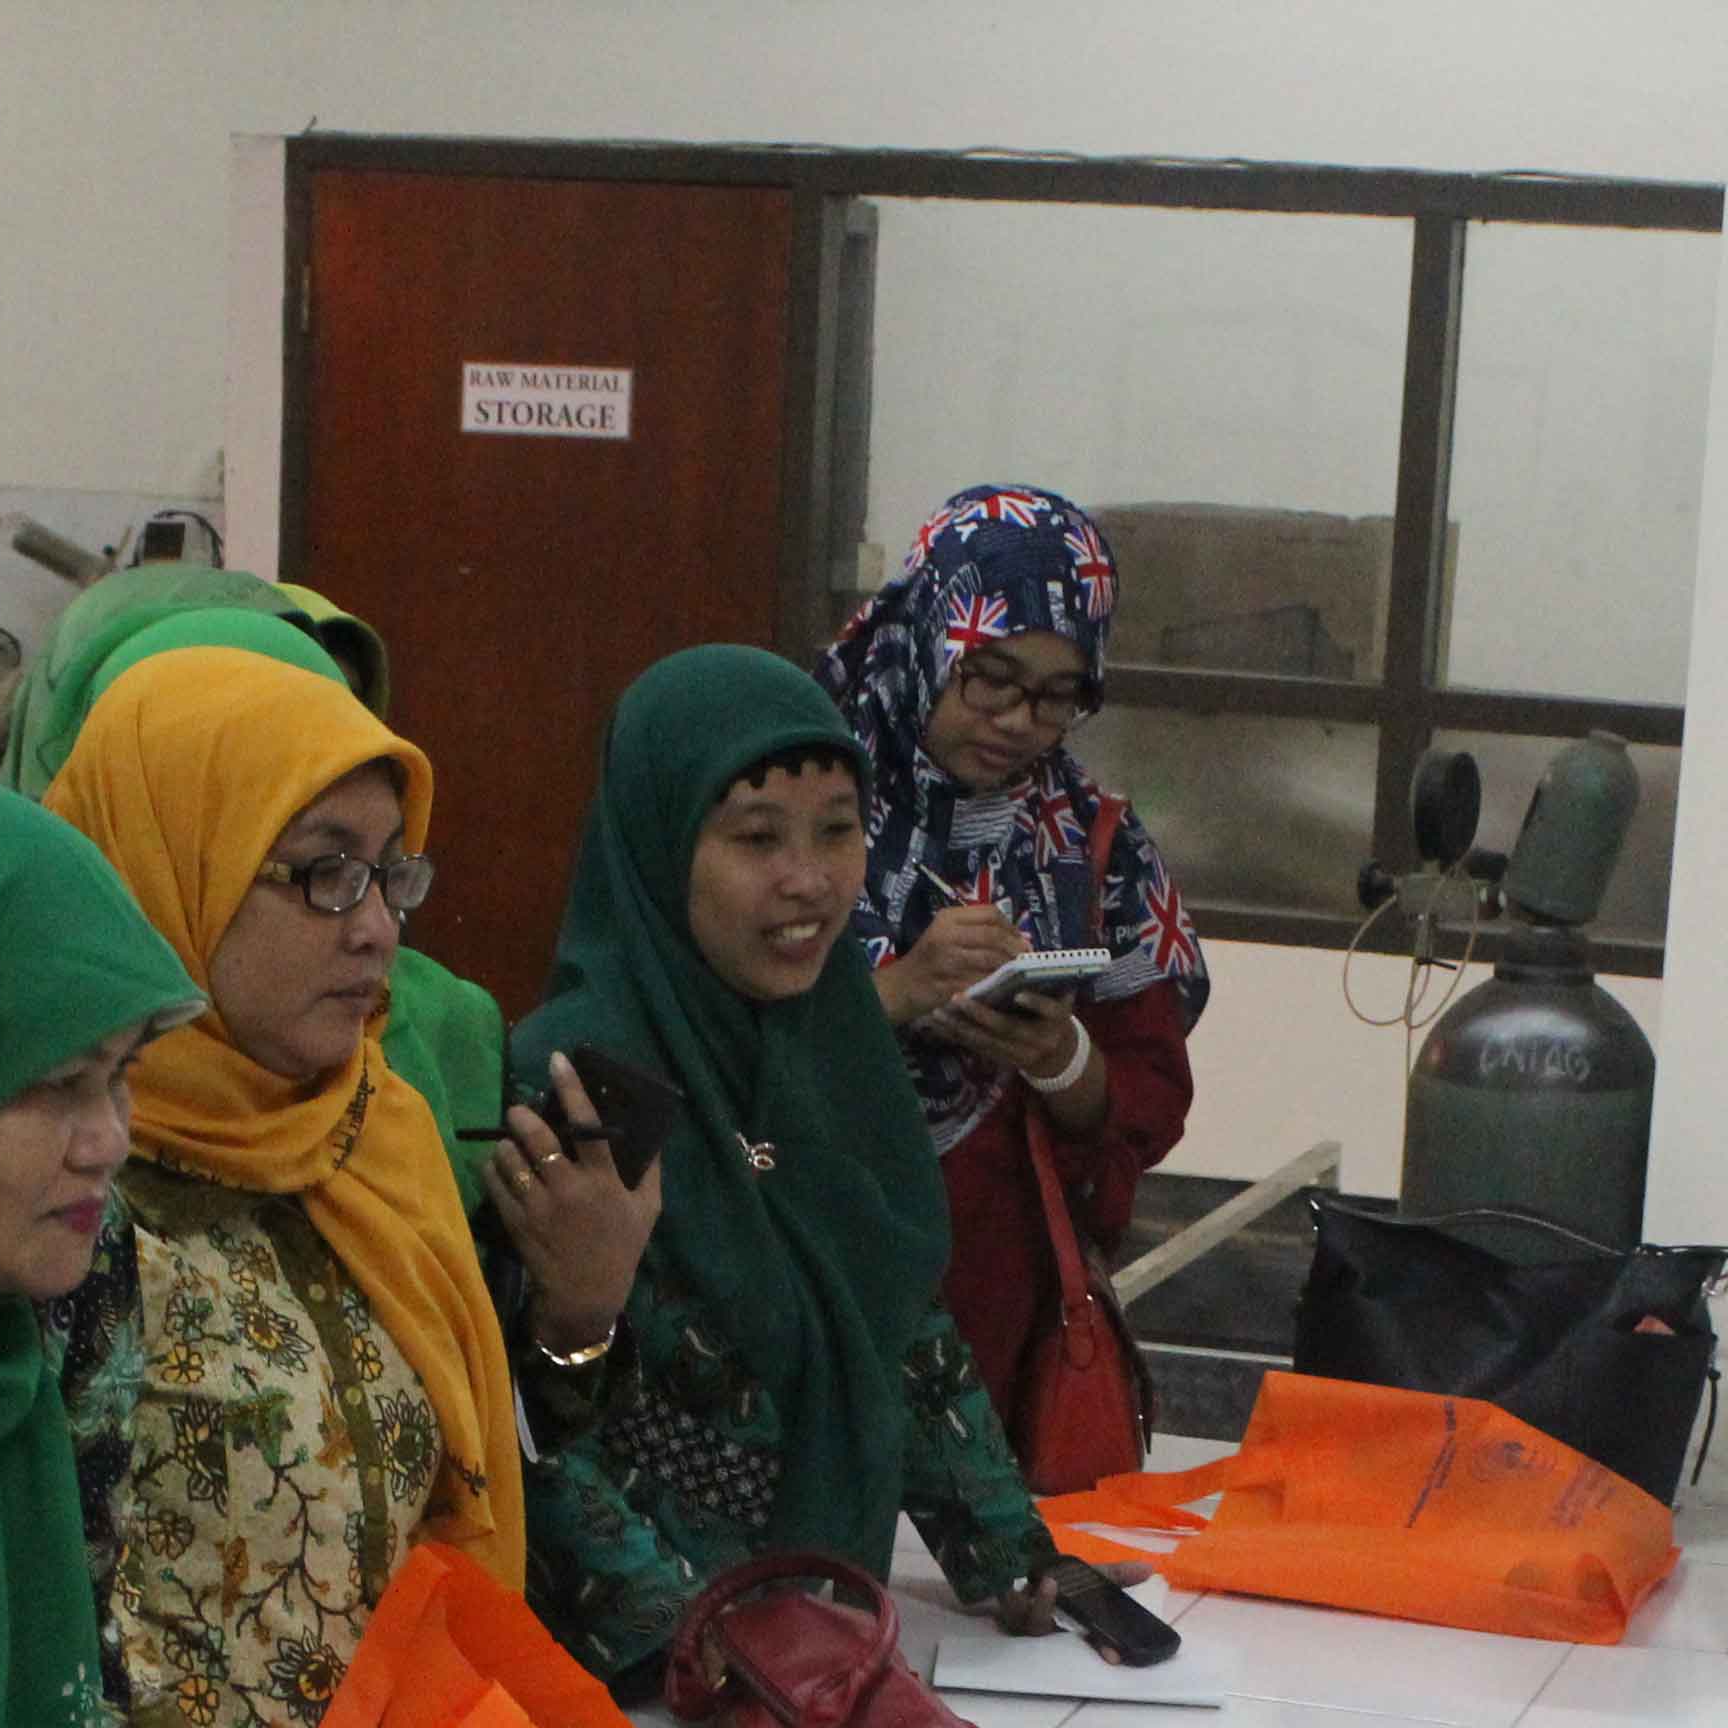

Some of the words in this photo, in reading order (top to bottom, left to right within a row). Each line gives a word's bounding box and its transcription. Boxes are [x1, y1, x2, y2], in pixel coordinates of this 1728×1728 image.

[470, 369, 514, 387] RAW
[522, 372, 623, 392] MATERIAL
[475, 400, 616, 429] STORAGE
